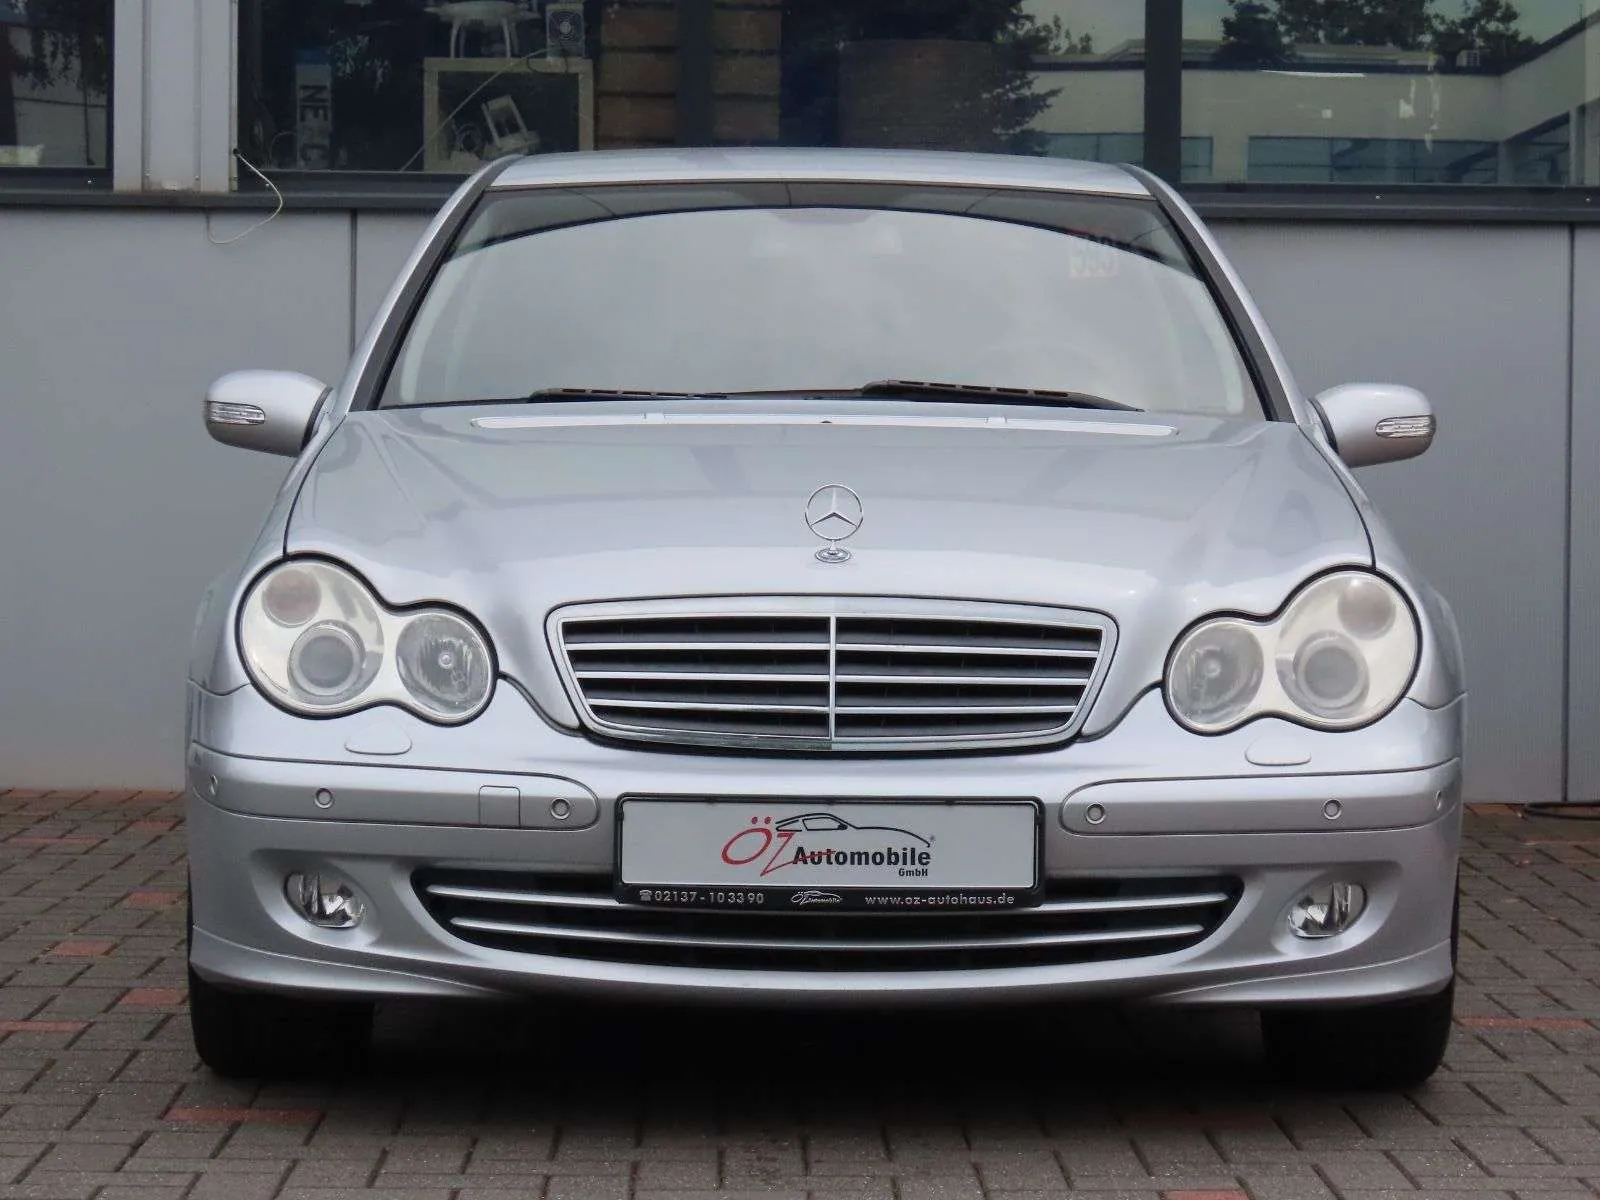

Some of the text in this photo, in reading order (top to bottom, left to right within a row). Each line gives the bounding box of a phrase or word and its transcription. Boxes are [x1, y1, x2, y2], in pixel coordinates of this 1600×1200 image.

[793, 846, 931, 866] Automobile
[898, 868, 929, 877] GmbH
[864, 892, 1015, 905] www.oz-autohaus.de
